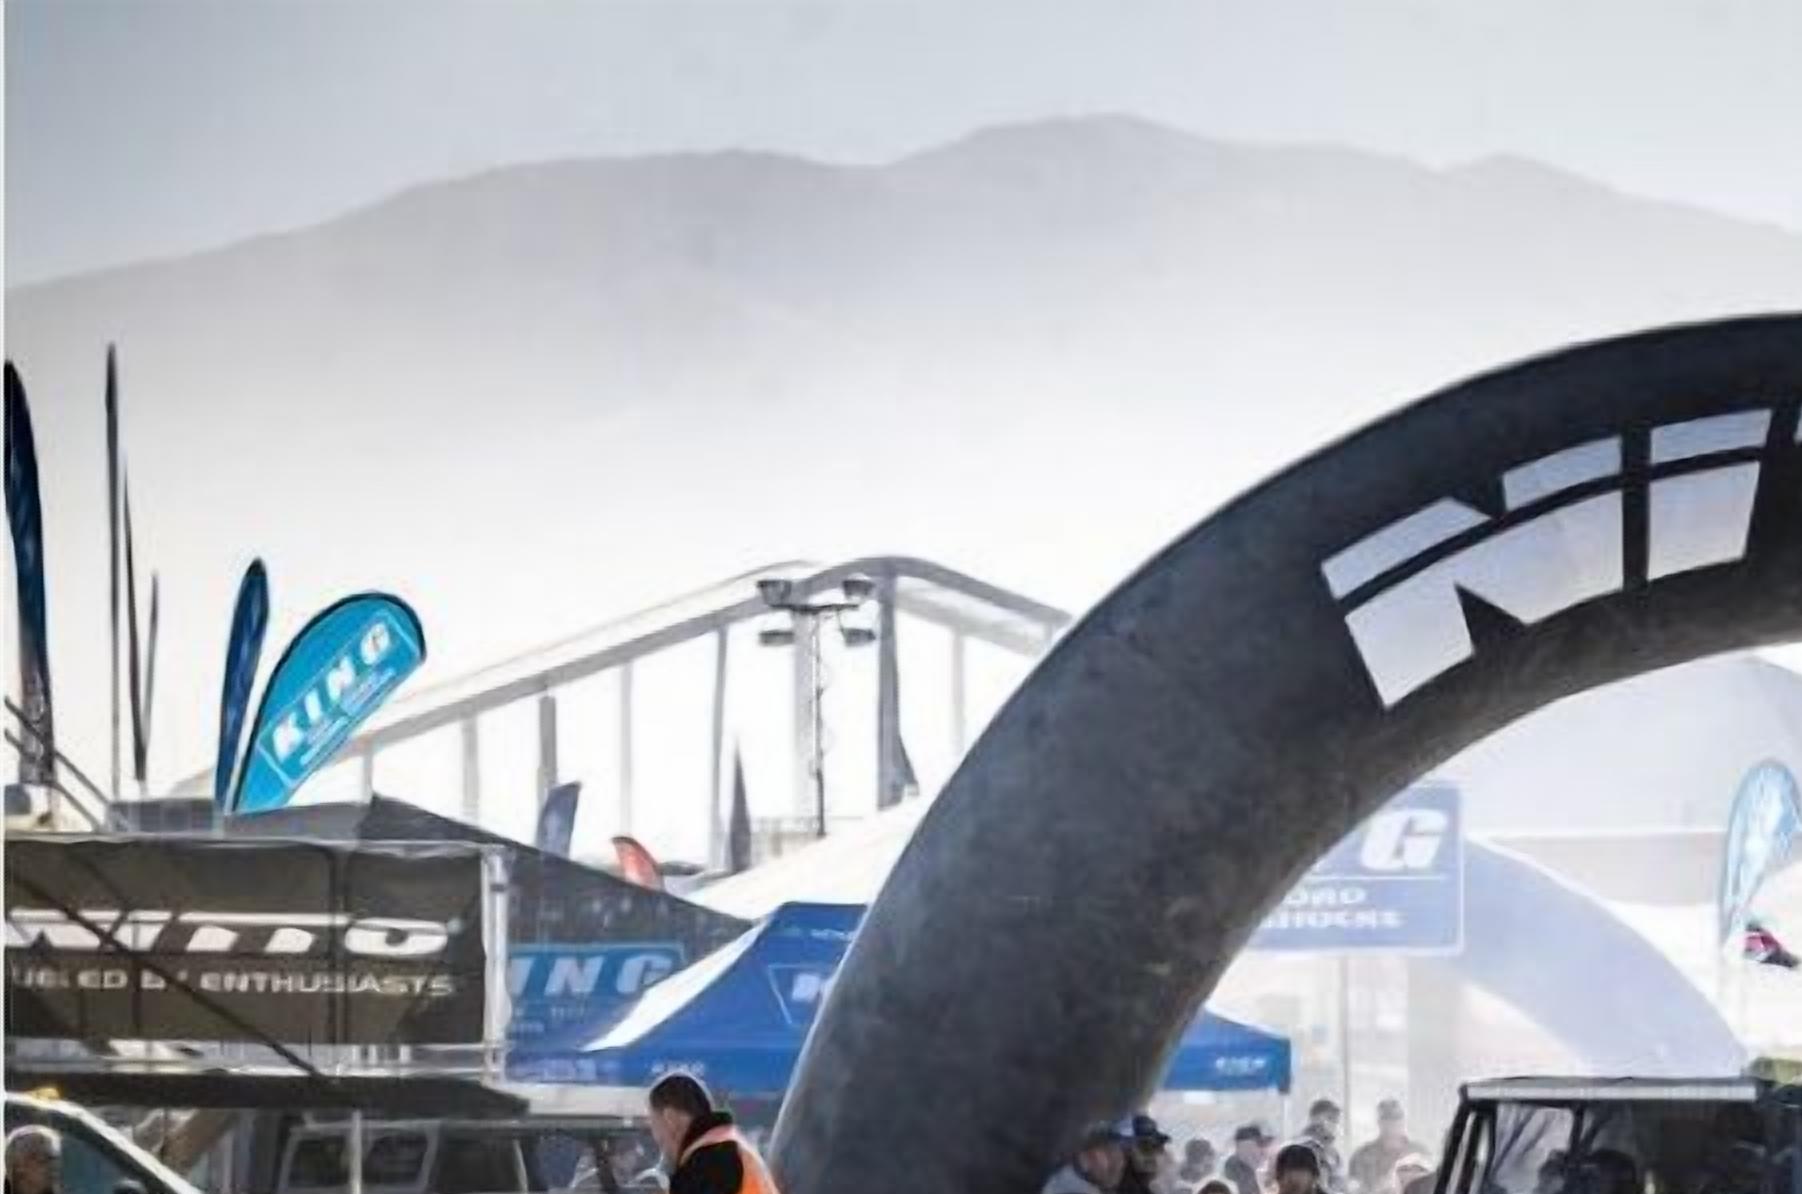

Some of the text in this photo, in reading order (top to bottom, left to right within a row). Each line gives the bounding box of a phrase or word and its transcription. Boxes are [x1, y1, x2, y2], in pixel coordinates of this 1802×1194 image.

[273, 622, 391, 764] KING
[4, 908, 448, 955] NITTO
[511, 955, 672, 997] ING
